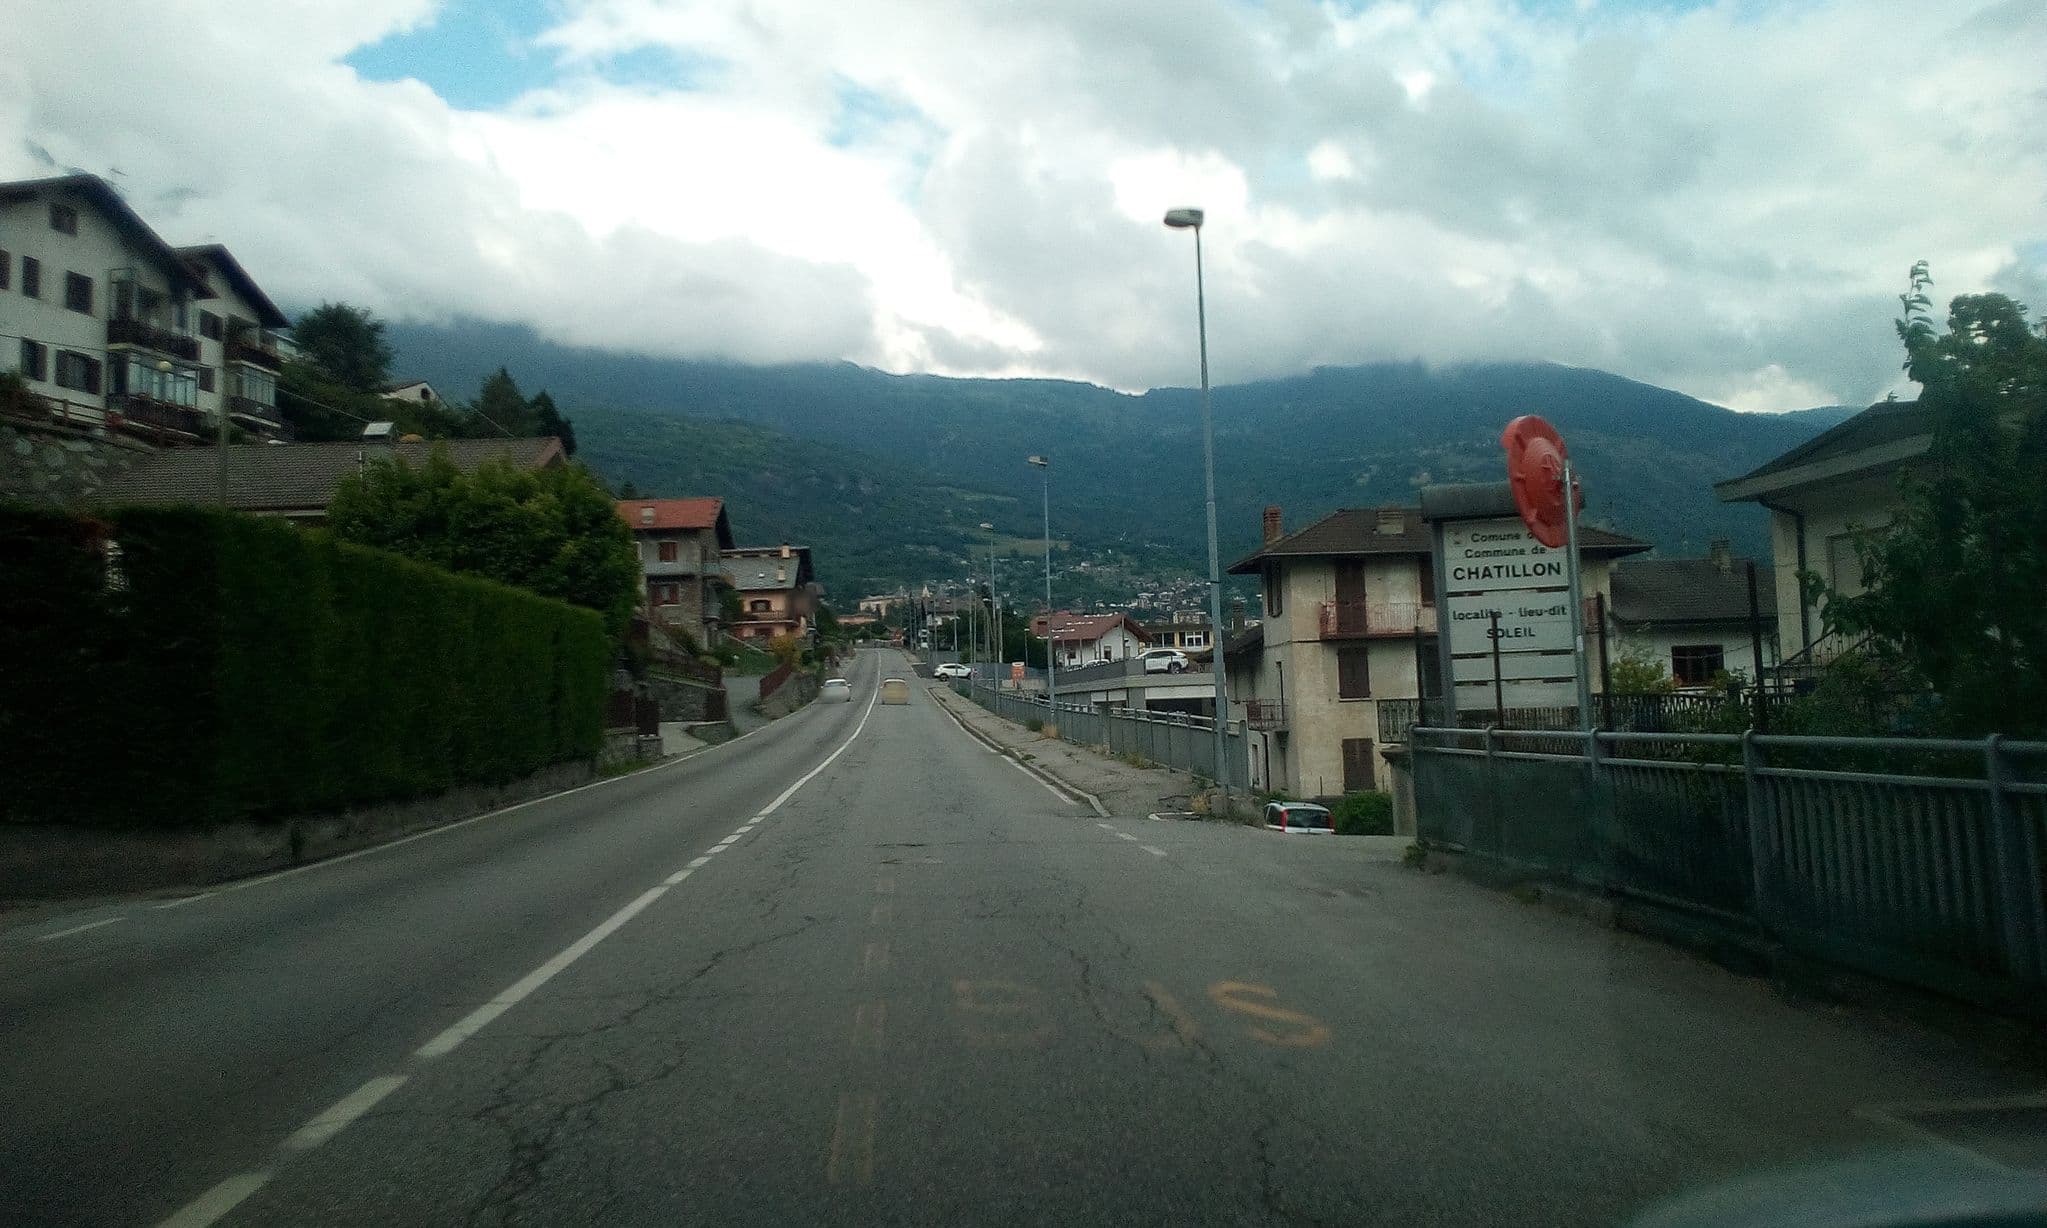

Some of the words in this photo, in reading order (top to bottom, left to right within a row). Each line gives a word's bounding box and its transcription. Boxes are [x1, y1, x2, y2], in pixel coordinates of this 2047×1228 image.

[1471, 532, 1521, 543] Comune
[1464, 547, 1525, 558] Commune
[1531, 545, 1546, 555] de
[1453, 562, 1561, 580] CHATILLON
[1518, 605, 1567, 617] lieu-dit
[1486, 627, 1536, 639] SOLEIL
